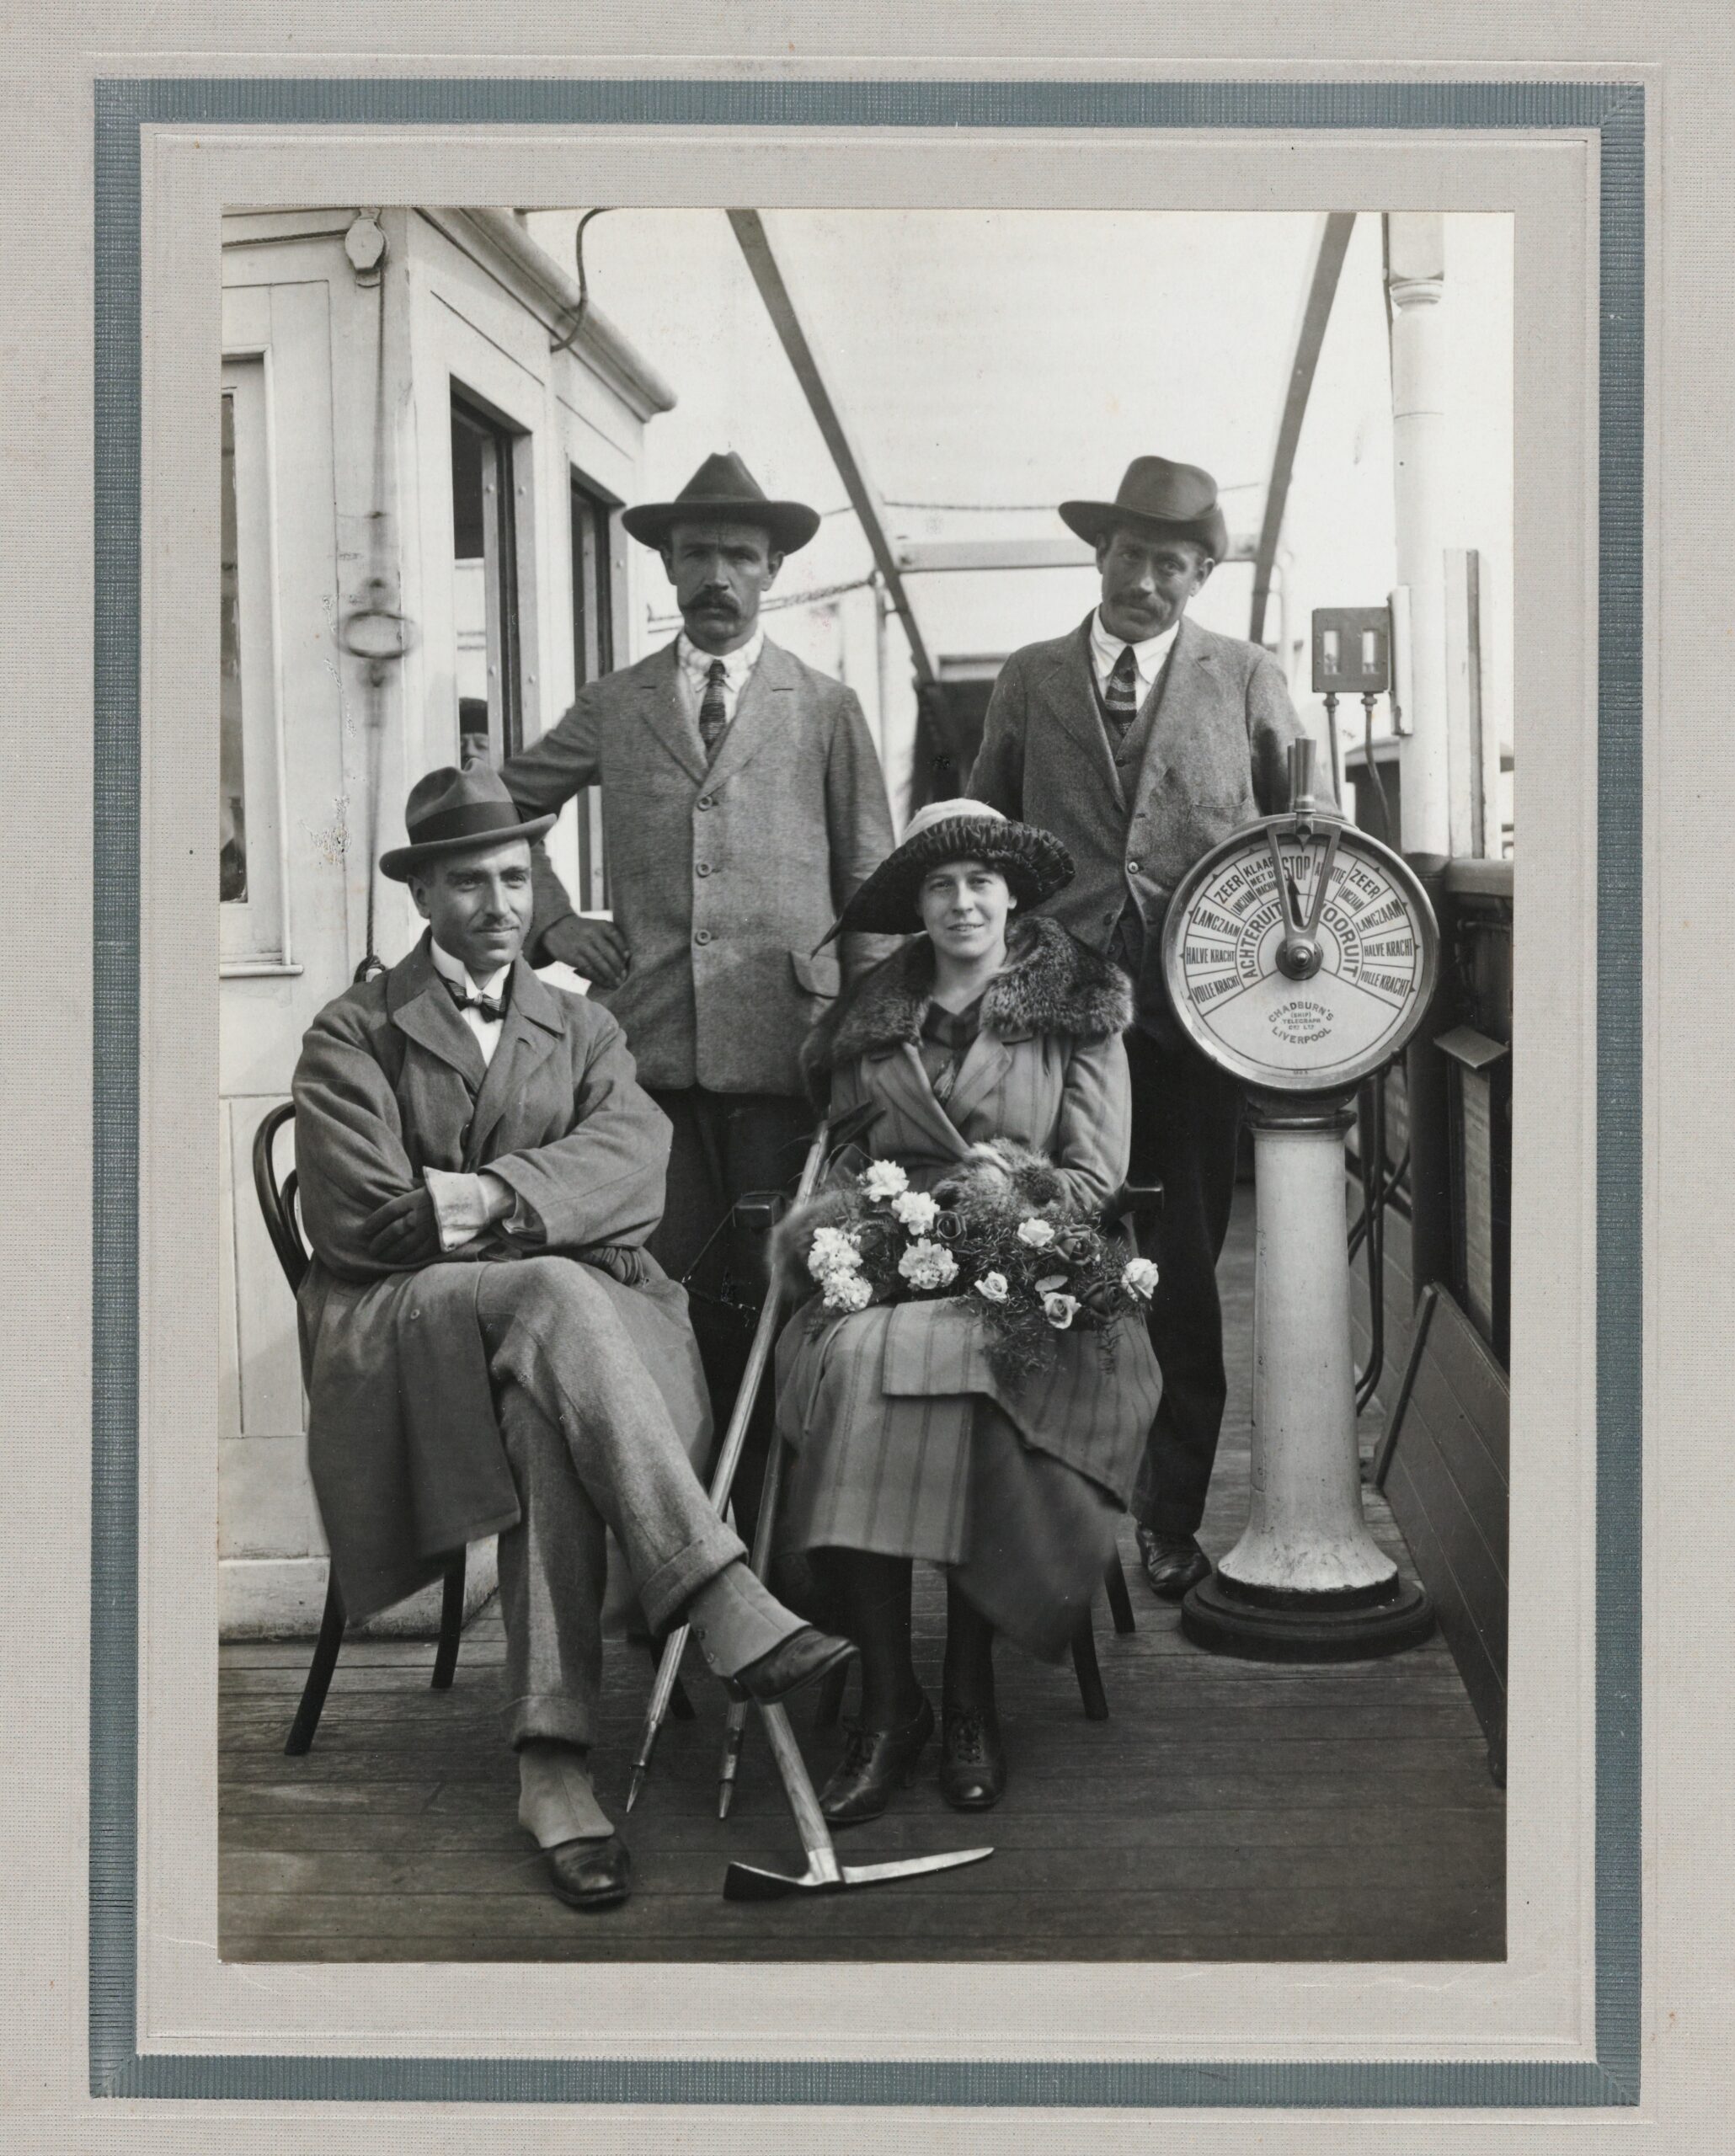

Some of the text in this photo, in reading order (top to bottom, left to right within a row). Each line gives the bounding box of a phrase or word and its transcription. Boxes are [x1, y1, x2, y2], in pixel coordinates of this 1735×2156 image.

[1250, 873, 1266, 887] MET
[1281, 856, 1311, 882] STOP
[1214, 874, 1245, 904] ZEER
[1349, 868, 1381, 899] ZEER
[1192, 906, 1241, 937] LANGZAAM
[1356, 899, 1406, 932] LANGZAAM
[1239, 901, 1282, 979] ACHTERUIT
[1364, 938, 1413, 957] HALVE KRACHT
[1186, 947, 1236, 965] HALVE KRACHT
[1191, 975, 1240, 1005] VOLLE KRACHT
[1360, 970, 1411, 997] VOLLE KRACHT
[1268, 1001, 1334, 1022] CHADBURN'S
[1272, 1026, 1332, 1044] LIVERPOOL
